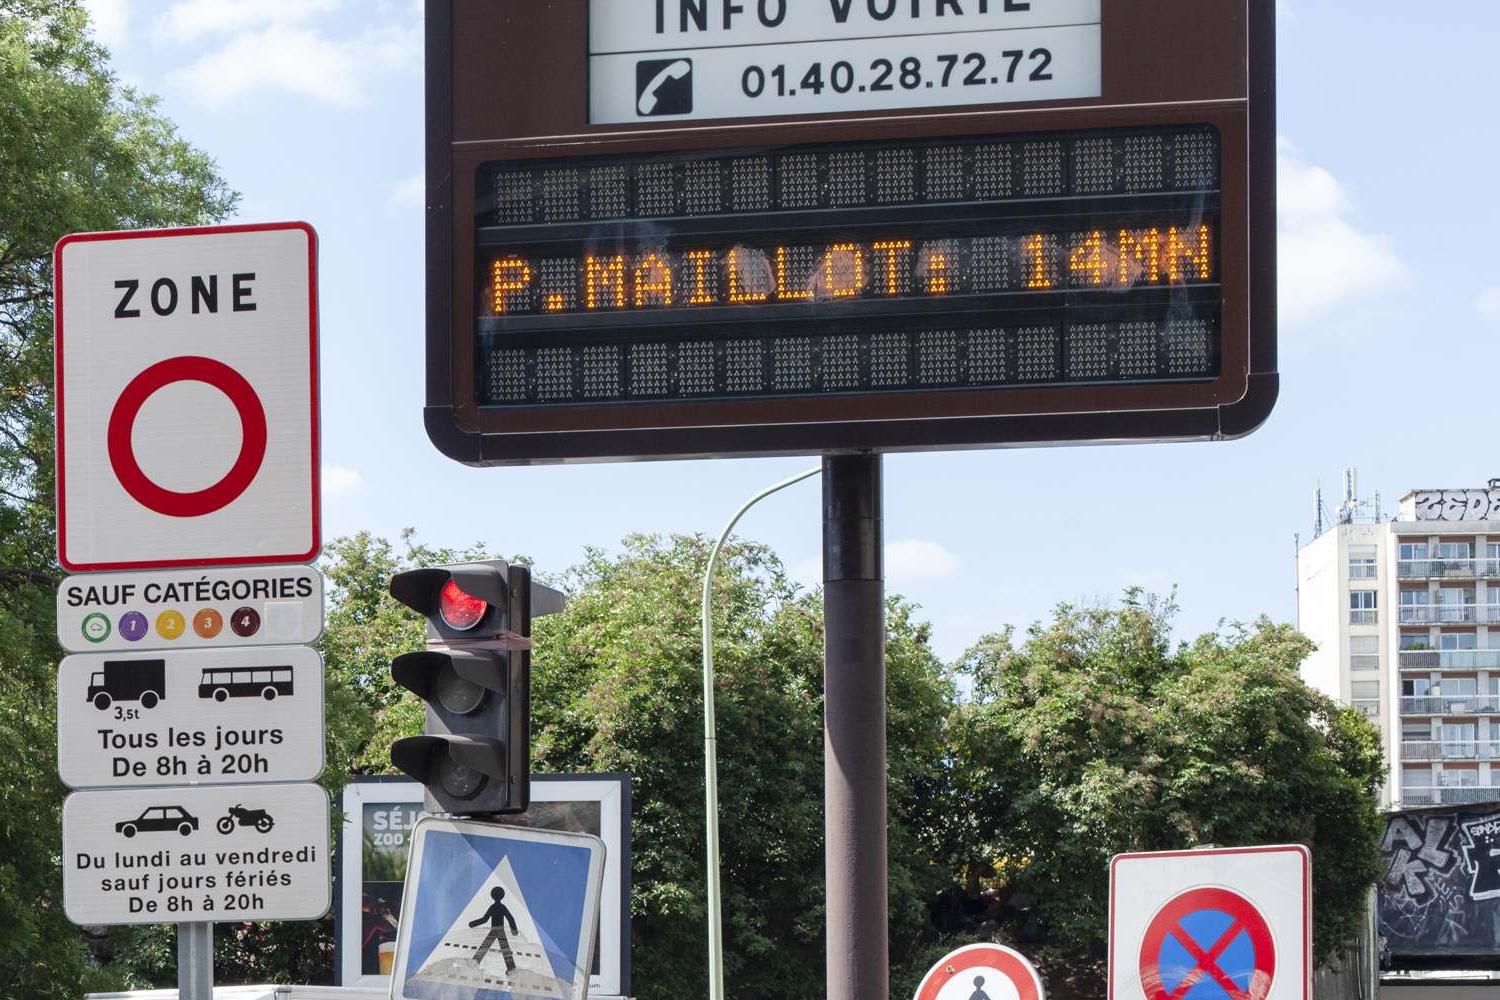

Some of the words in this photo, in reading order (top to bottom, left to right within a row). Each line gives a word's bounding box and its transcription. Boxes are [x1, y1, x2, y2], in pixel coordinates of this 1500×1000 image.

[742, 47, 1053, 99] 01.40.28.72.72
[1024, 224, 1210, 289] 14MN
[114, 272, 257, 319] ZONE
[67, 584, 136, 607] SAUF
[143, 576, 312, 604] CATÉGORIES
[129, 620, 137, 631] 1
[165, 619, 175, 630] 2
[203, 617, 212, 629] 3
[241, 616, 251, 628] 4
[114, 706, 139, 722] 3,5t
[98, 729, 158, 749] Tous
[168, 727, 206, 747] les
[215, 725, 283, 750] jours
[112, 757, 146, 777] De
[156, 756, 187, 776] 8h
[198, 755, 211, 775] à
[221, 754, 268, 774] 20h
[374, 833, 403, 845] ZOO
[77, 853, 105, 869] Du
[115, 851, 170, 868] lundi
[180, 854, 206, 866] au
[216, 847, 316, 865] vendredi
[101, 874, 149, 891] sauf
[158, 872, 216, 892] jours
[226, 870, 291, 887] fériés
[129, 897, 157, 913] De
[167, 895, 192, 912] 8h
[203, 894, 215, 910] à
[224, 894, 264, 910] 20h
